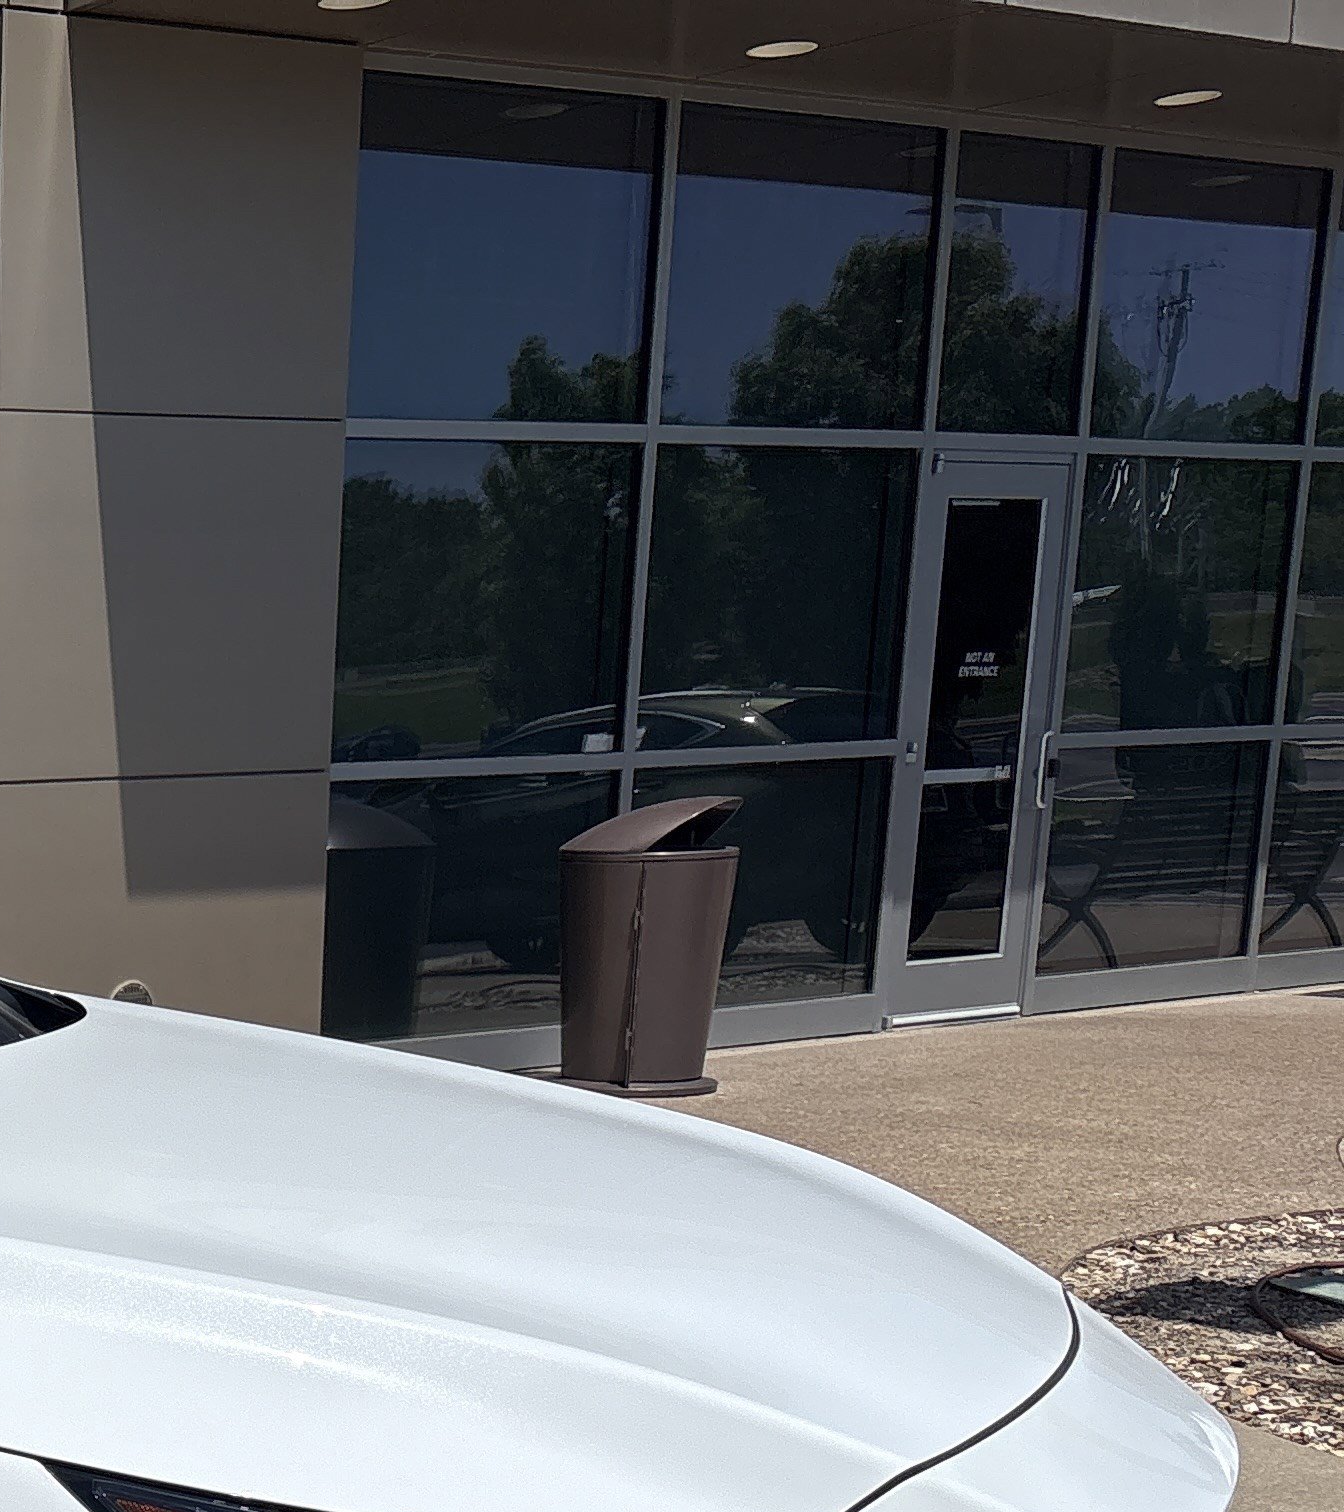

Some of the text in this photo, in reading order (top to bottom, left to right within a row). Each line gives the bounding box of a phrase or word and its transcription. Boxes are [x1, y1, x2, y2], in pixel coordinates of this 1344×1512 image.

[964, 651, 996, 663] NOT AN
[958, 665, 999, 677] ENTRANCE
